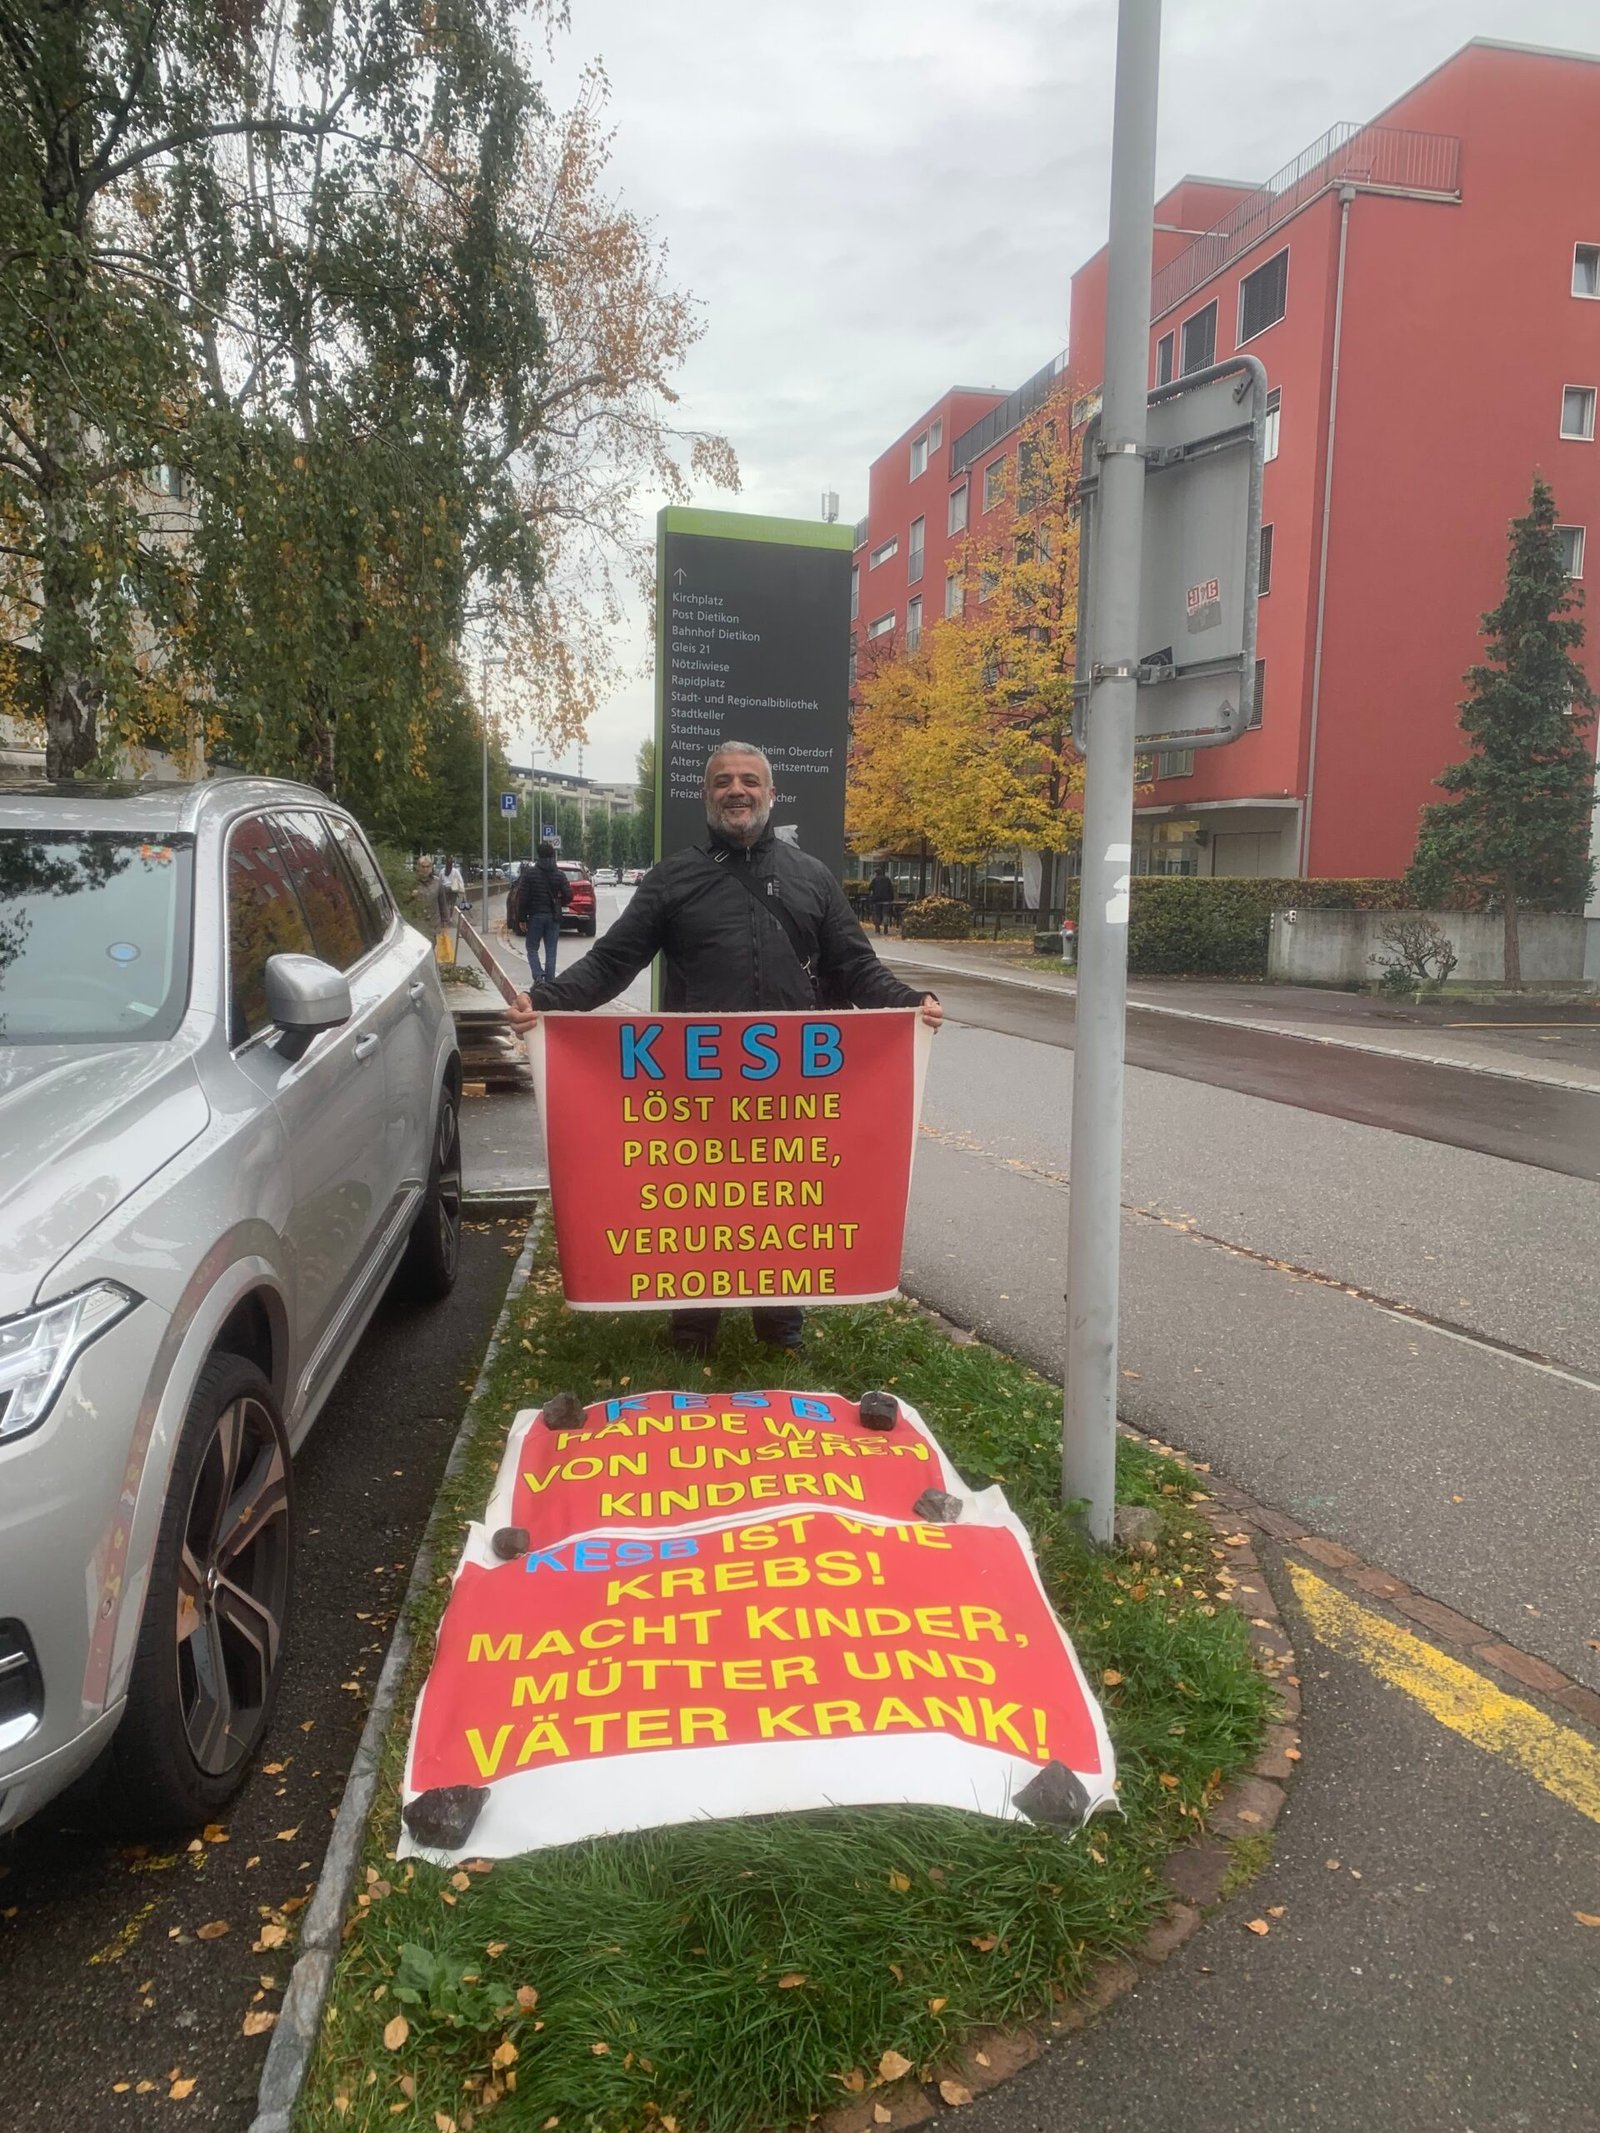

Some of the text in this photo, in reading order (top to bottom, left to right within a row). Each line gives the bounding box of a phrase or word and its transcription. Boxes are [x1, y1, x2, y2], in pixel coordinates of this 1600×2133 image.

[672, 592, 724, 607] Kirchplatz
[672, 609, 740, 624] Post Dietikon
[672, 626, 760, 642] Bahnhof Dietikon
[672, 642, 711, 654] Gleis 21
[672, 658, 730, 672] Nötzliwiese
[672, 675, 726, 689] Rapidplatz
[671, 691, 819, 710] Stadt- und Regionalbibliothek
[671, 707, 725, 721] Stadtkeller
[671, 724, 721, 736] Stadthaus
[671, 740, 704, 752] Alters-
[707, 743, 722, 752] un
[788, 746, 833, 758] Oberdorf
[670, 772, 705, 785] Stadtp
[671, 756, 829, 773] Alters- eitszentrum
[670, 788, 703, 800] Freizei
[619, 1022, 845, 1081] KESB
[622, 1090, 841, 1123] LÖST KEINE
[622, 1136, 842, 1168] PROBLEME,
[639, 1180, 825, 1210] SONDERN
[606, 1222, 860, 1255] VERURSACHT
[630, 1268, 837, 1299] PROBLEME
[605, 1393, 836, 1423] KESB
[522, 1440, 930, 1495] VON UNSEREN
[600, 1472, 866, 1518] KINDERN
[525, 1538, 700, 1573] KESB
[722, 1514, 816, 1553] IST
[606, 1551, 886, 1606] KREBS!
[466, 1605, 1029, 1663] MACHT KINDER,
[511, 1649, 997, 1708] MÜTTER UND
[464, 1696, 1051, 1778] VÄTER KRANK!
